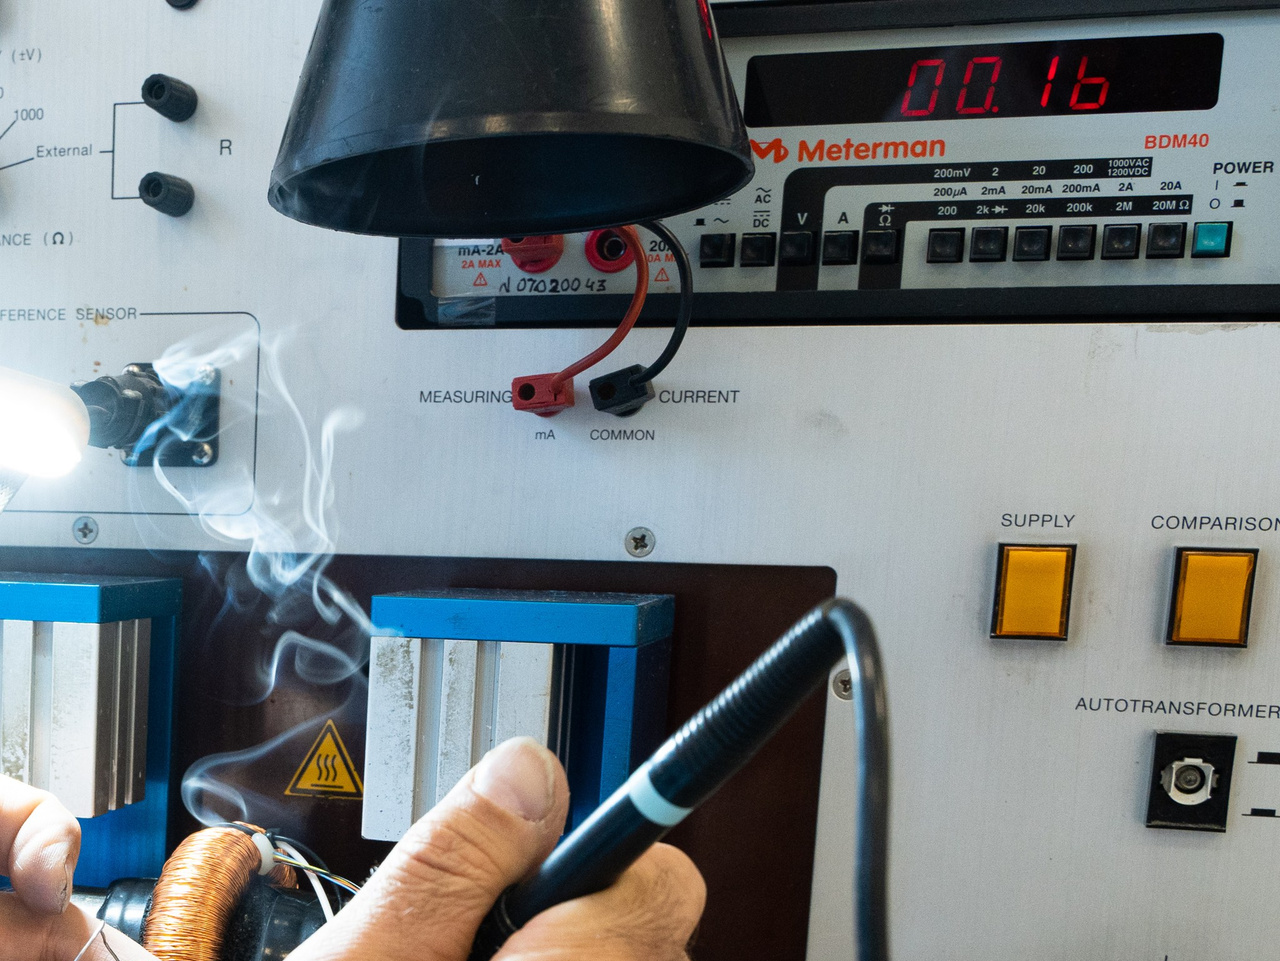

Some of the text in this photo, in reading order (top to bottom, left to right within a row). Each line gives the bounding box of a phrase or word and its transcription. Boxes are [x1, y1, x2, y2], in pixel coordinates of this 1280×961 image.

[13, 108, 44, 121] 1000
[220, 139, 233, 156] R
[1144, 133, 1210, 150] BDM40
[36, 143, 93, 158] External
[797, 138, 946, 163] Meterman
[1108, 158, 1150, 168] 1000VAC
[1213, 161, 1274, 175] POWER
[933, 164, 1094, 179] 200mV 2 20 200
[1107, 167, 1150, 178] 1200VDC
[981, 185, 1006, 196] 2mA
[1022, 184, 1053, 195] 20mA
[1062, 182, 1101, 194] 200mA
[1118, 182, 1134, 192] 2A
[1160, 181, 1182, 191] 20A
[754, 194, 771, 204] AC
[937, 206, 958, 216] 200
[976, 205, 990, 215] 2k
[1026, 203, 1046, 214] 20k
[1066, 202, 1093, 213] 200k
[1115, 201, 1133, 211] 2M
[1152, 200, 1176, 211] 20M
[753, 218, 769, 228] DC
[797, 212, 808, 225] V
[837, 212, 849, 224] A
[458, 244, 505, 256] mA-2A
[649, 240, 671, 252] 20
[462, 259, 501, 269] 2A MAX
[76, 308, 137, 320] SENSOR
[420, 390, 740, 404] MEASURING CURRENT
[535, 429, 556, 440] mA
[590, 429, 655, 441] COMMON
[1001, 513, 1075, 528] SUPPLY
[1075, 697, 1280, 719] AUTOTRANSFORMER
